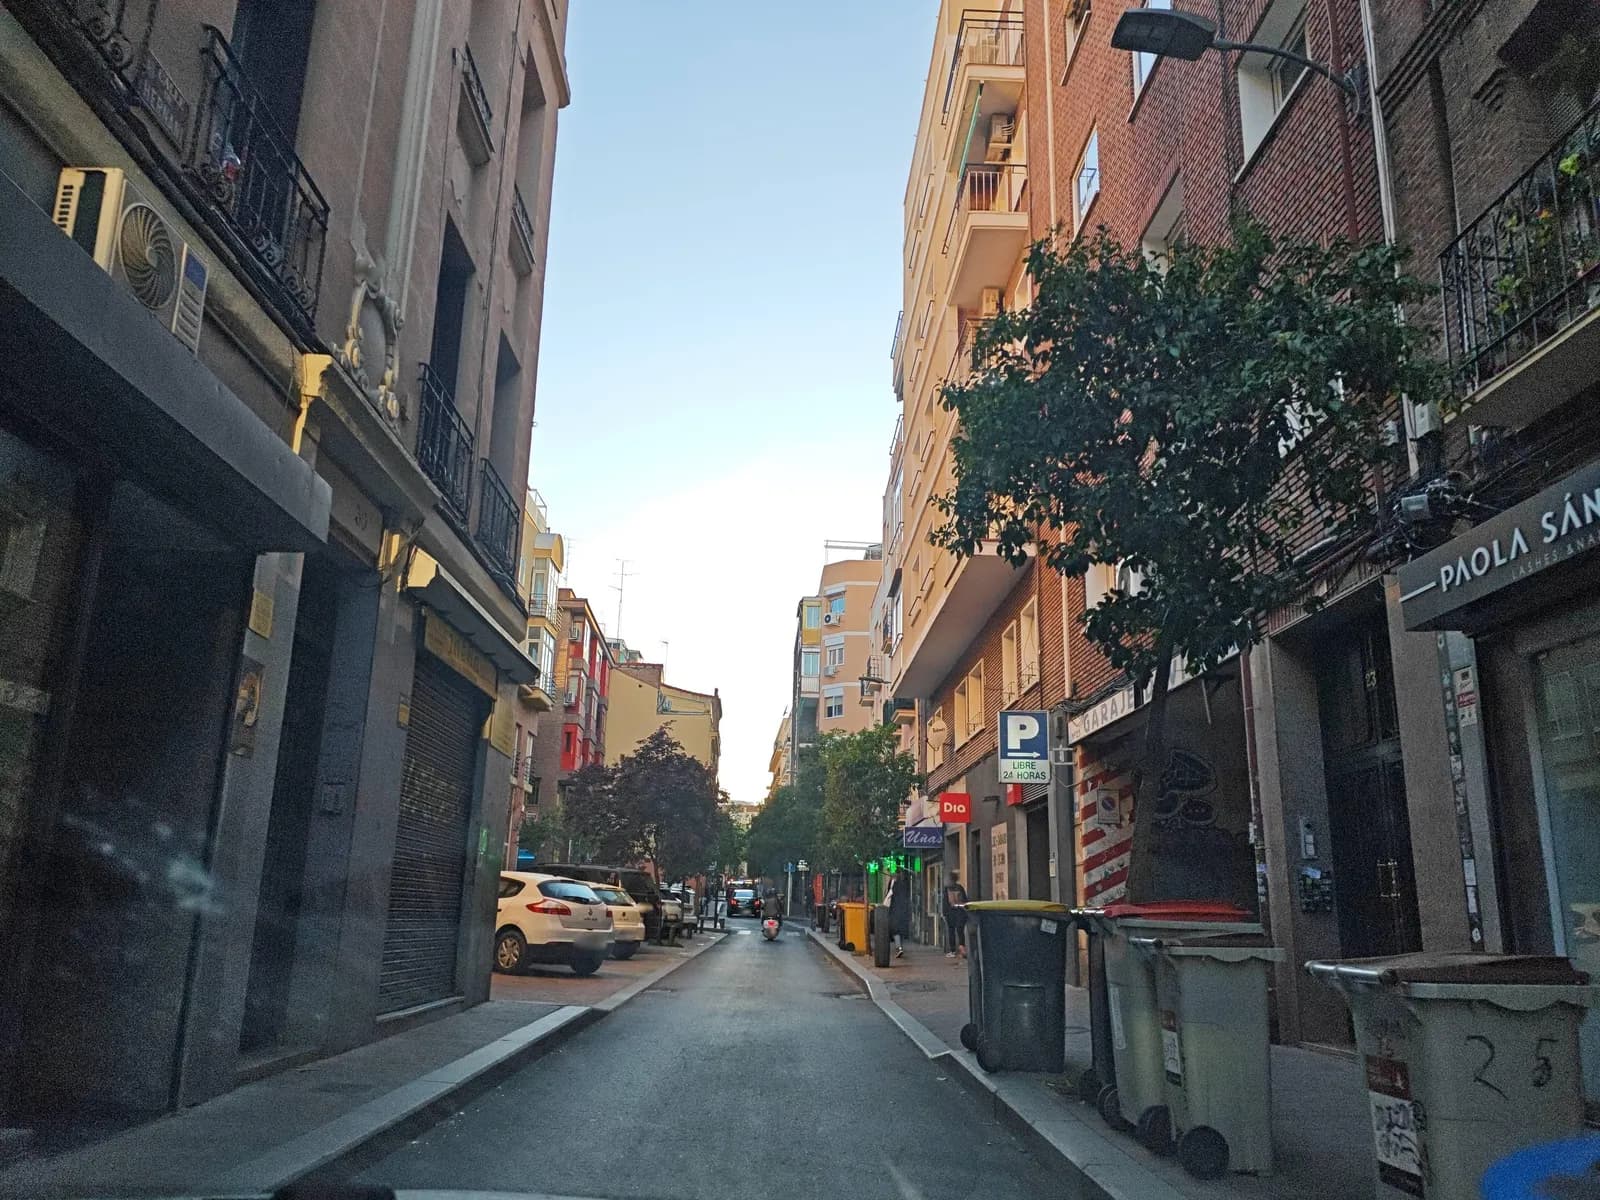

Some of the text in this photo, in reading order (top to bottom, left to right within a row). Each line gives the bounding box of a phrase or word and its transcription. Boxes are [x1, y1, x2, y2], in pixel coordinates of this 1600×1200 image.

[1440, 527, 1529, 592] PAOLA
[1365, 669, 1377, 688] 23
[1083, 687, 1134, 732] GARAJE
[1008, 715, 1040, 750] P
[1003, 771, 1047, 780] 24 HORAS
[1012, 761, 1037, 770] LIBRE
